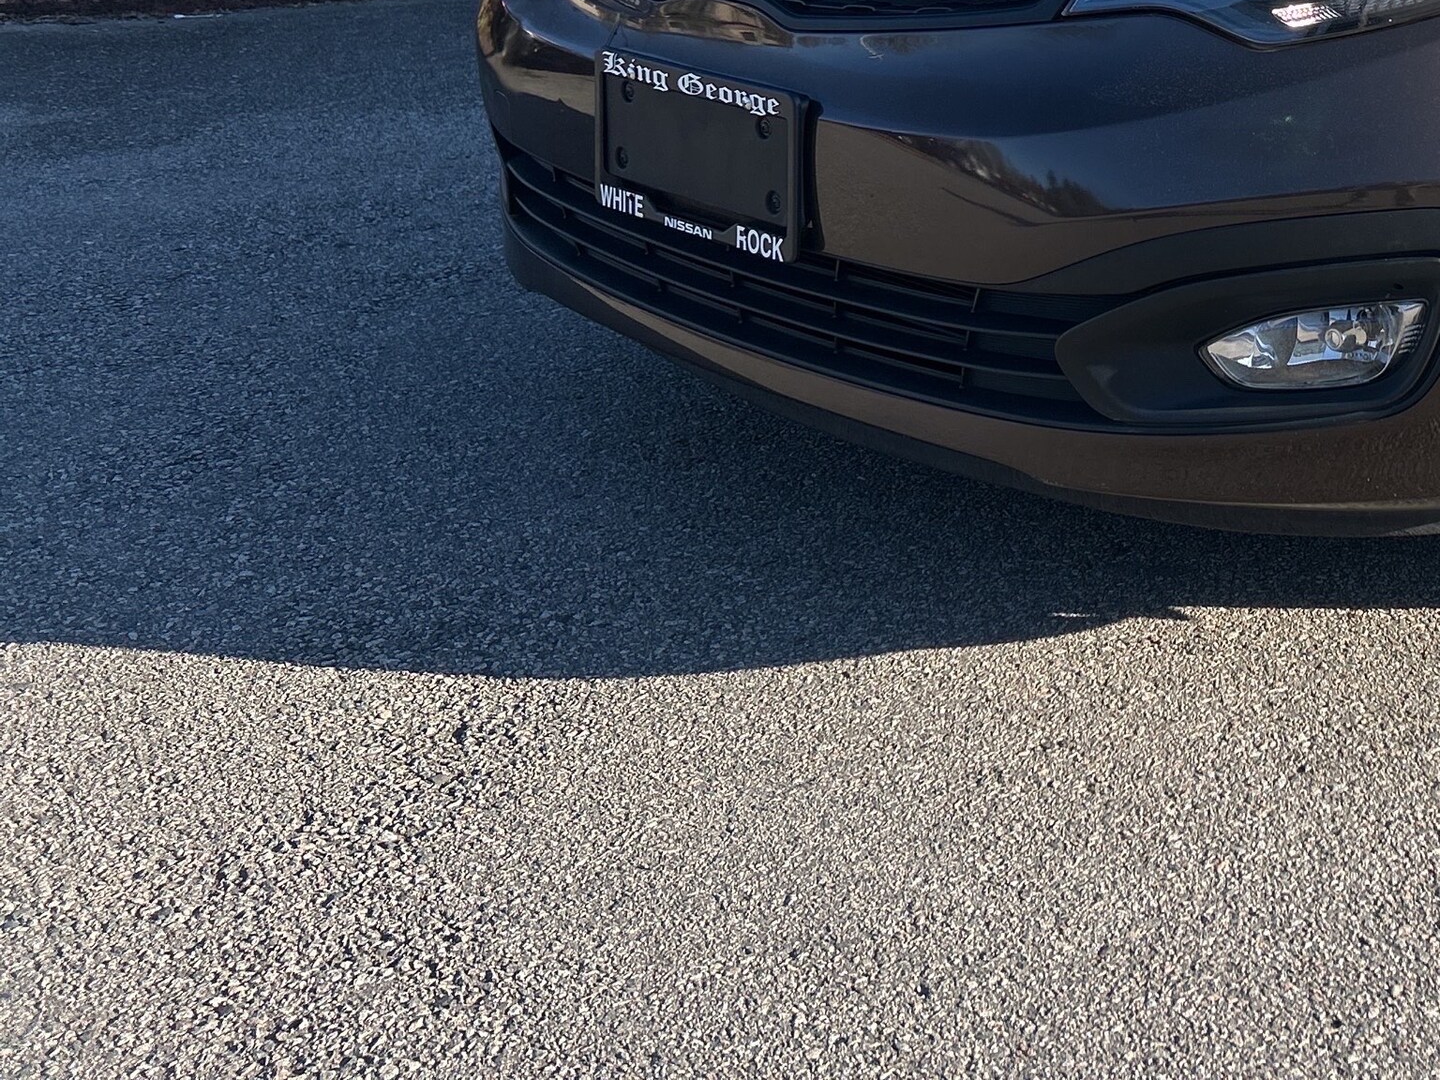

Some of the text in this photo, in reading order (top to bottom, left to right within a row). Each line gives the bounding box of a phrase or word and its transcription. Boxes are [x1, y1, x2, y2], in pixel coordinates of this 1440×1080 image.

[601, 50, 780, 117] King George
[600, 183, 784, 263] WHITE NISSAN ROCK
